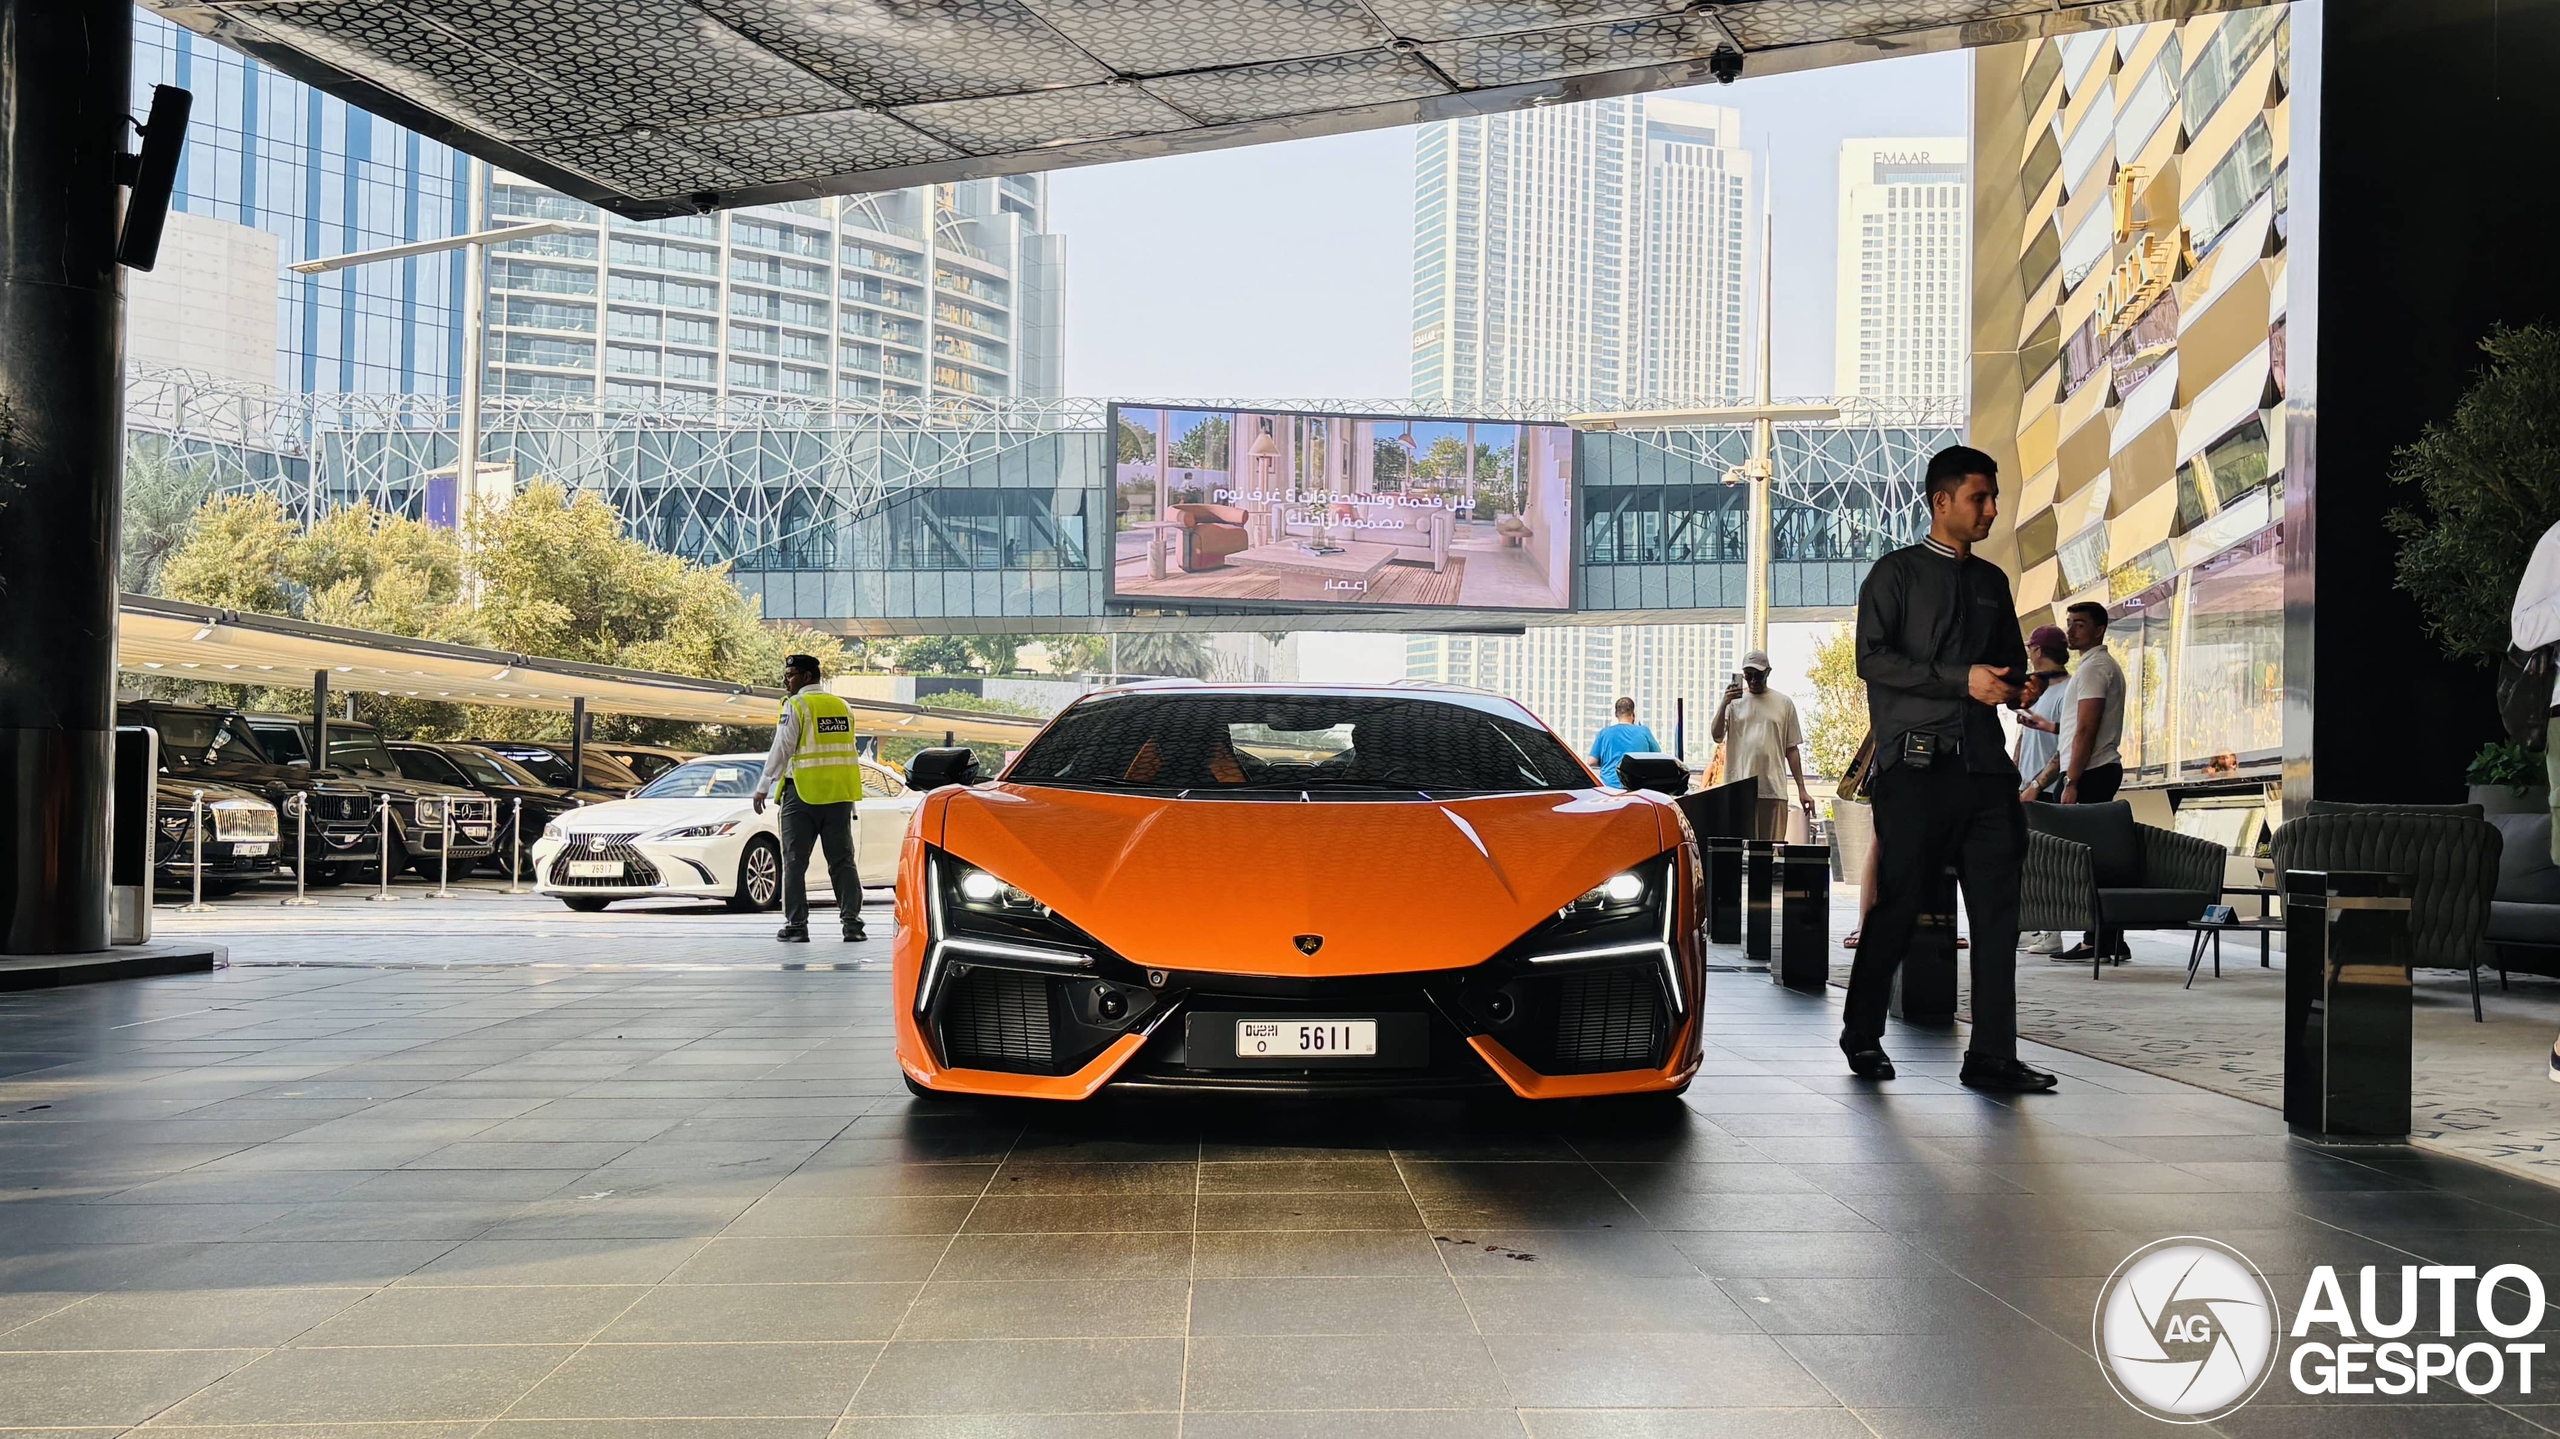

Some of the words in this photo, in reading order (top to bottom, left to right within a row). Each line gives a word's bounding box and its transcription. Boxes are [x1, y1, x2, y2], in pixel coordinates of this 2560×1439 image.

[1873, 151, 1930, 165] EMAAR
[2095, 232, 2155, 339] ROLEX
[1213, 487, 1244, 504] نوم
[1247, 487, 1281, 505] غرف
[1329, 488, 1395, 509] وفسيحة
[1397, 492, 1443, 508] فخمة
[1445, 494, 1476, 512] فلل
[1300, 1026, 1350, 1050] 5611
